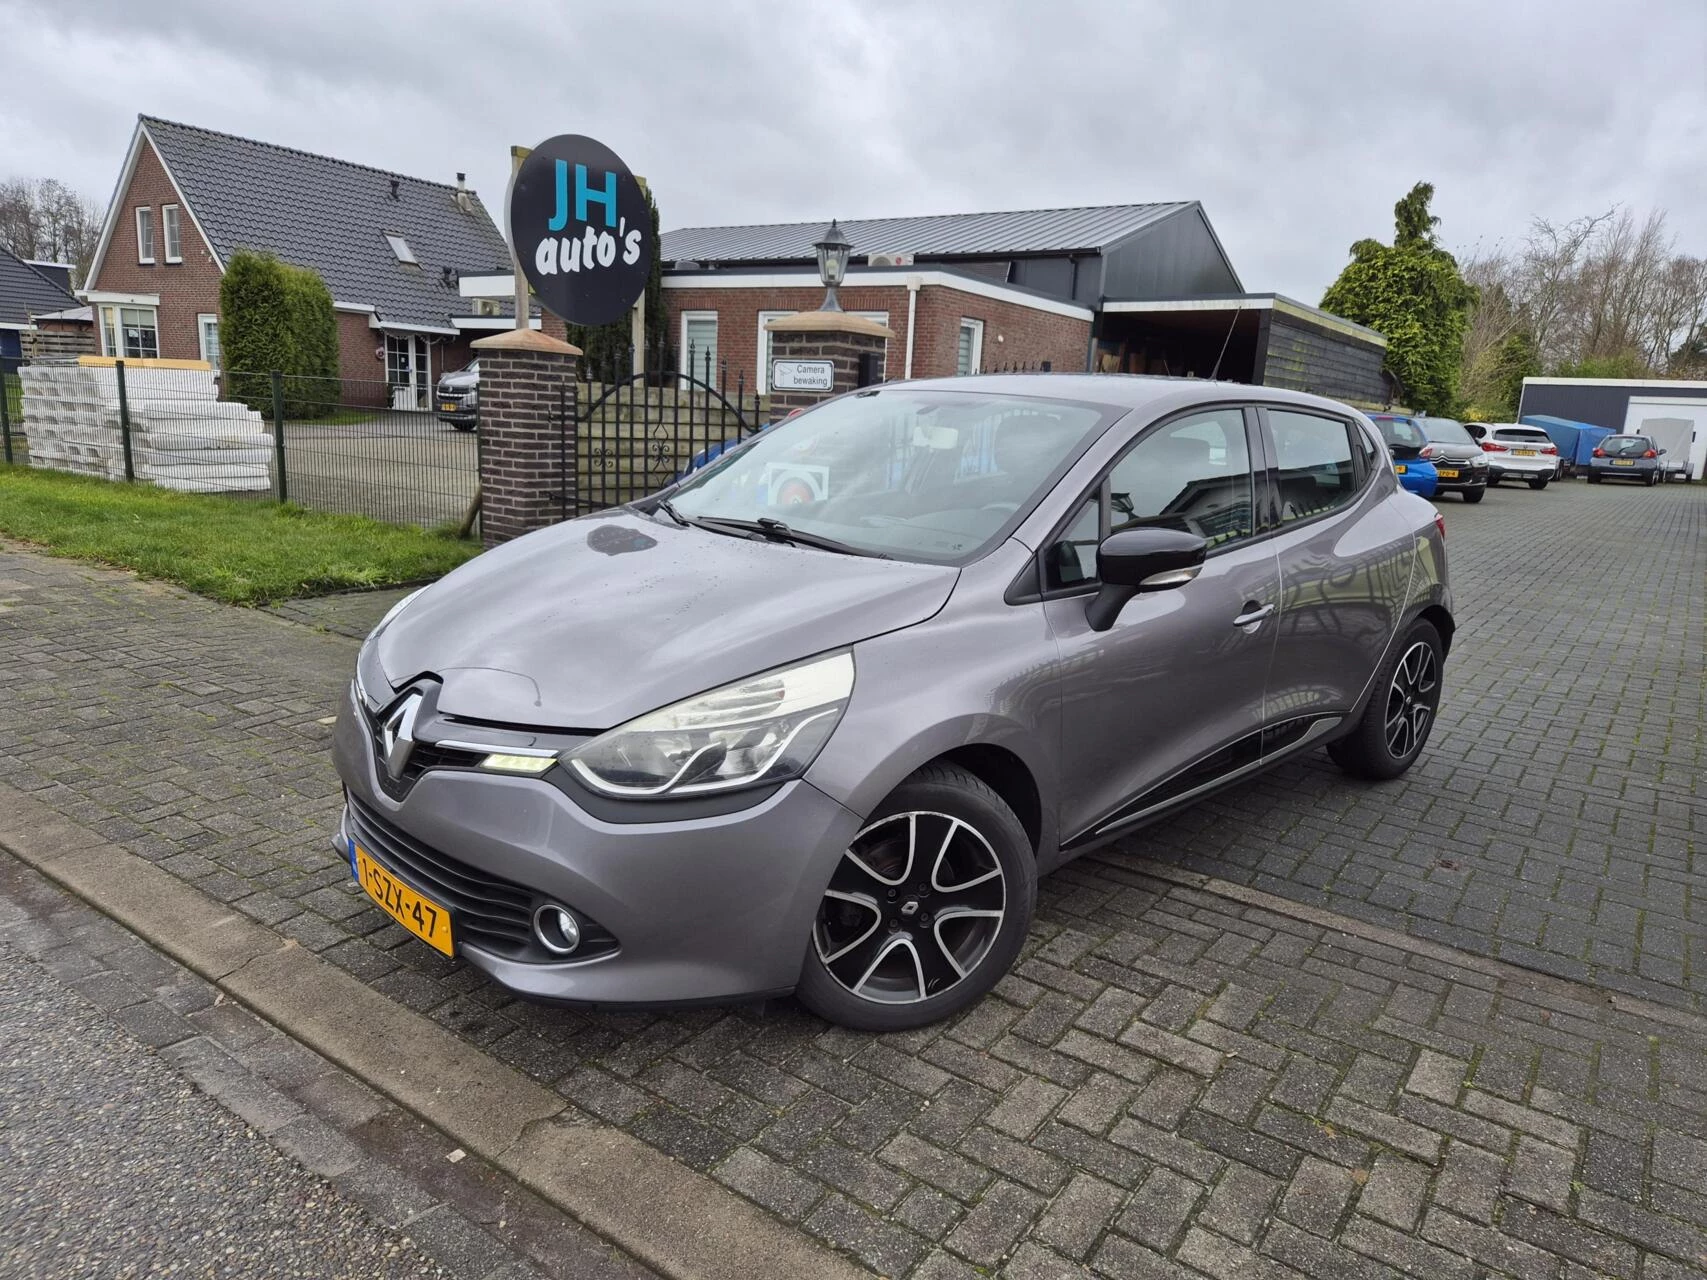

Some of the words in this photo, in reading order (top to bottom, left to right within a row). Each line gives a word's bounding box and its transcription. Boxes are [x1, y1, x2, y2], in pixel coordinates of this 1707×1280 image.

[548, 159, 617, 232] JH
[535, 216, 642, 276] auto's
[793, 375, 828, 388] bewaking
[796, 364, 825, 374] Camera
[361, 857, 437, 938] 1-SZX-47
